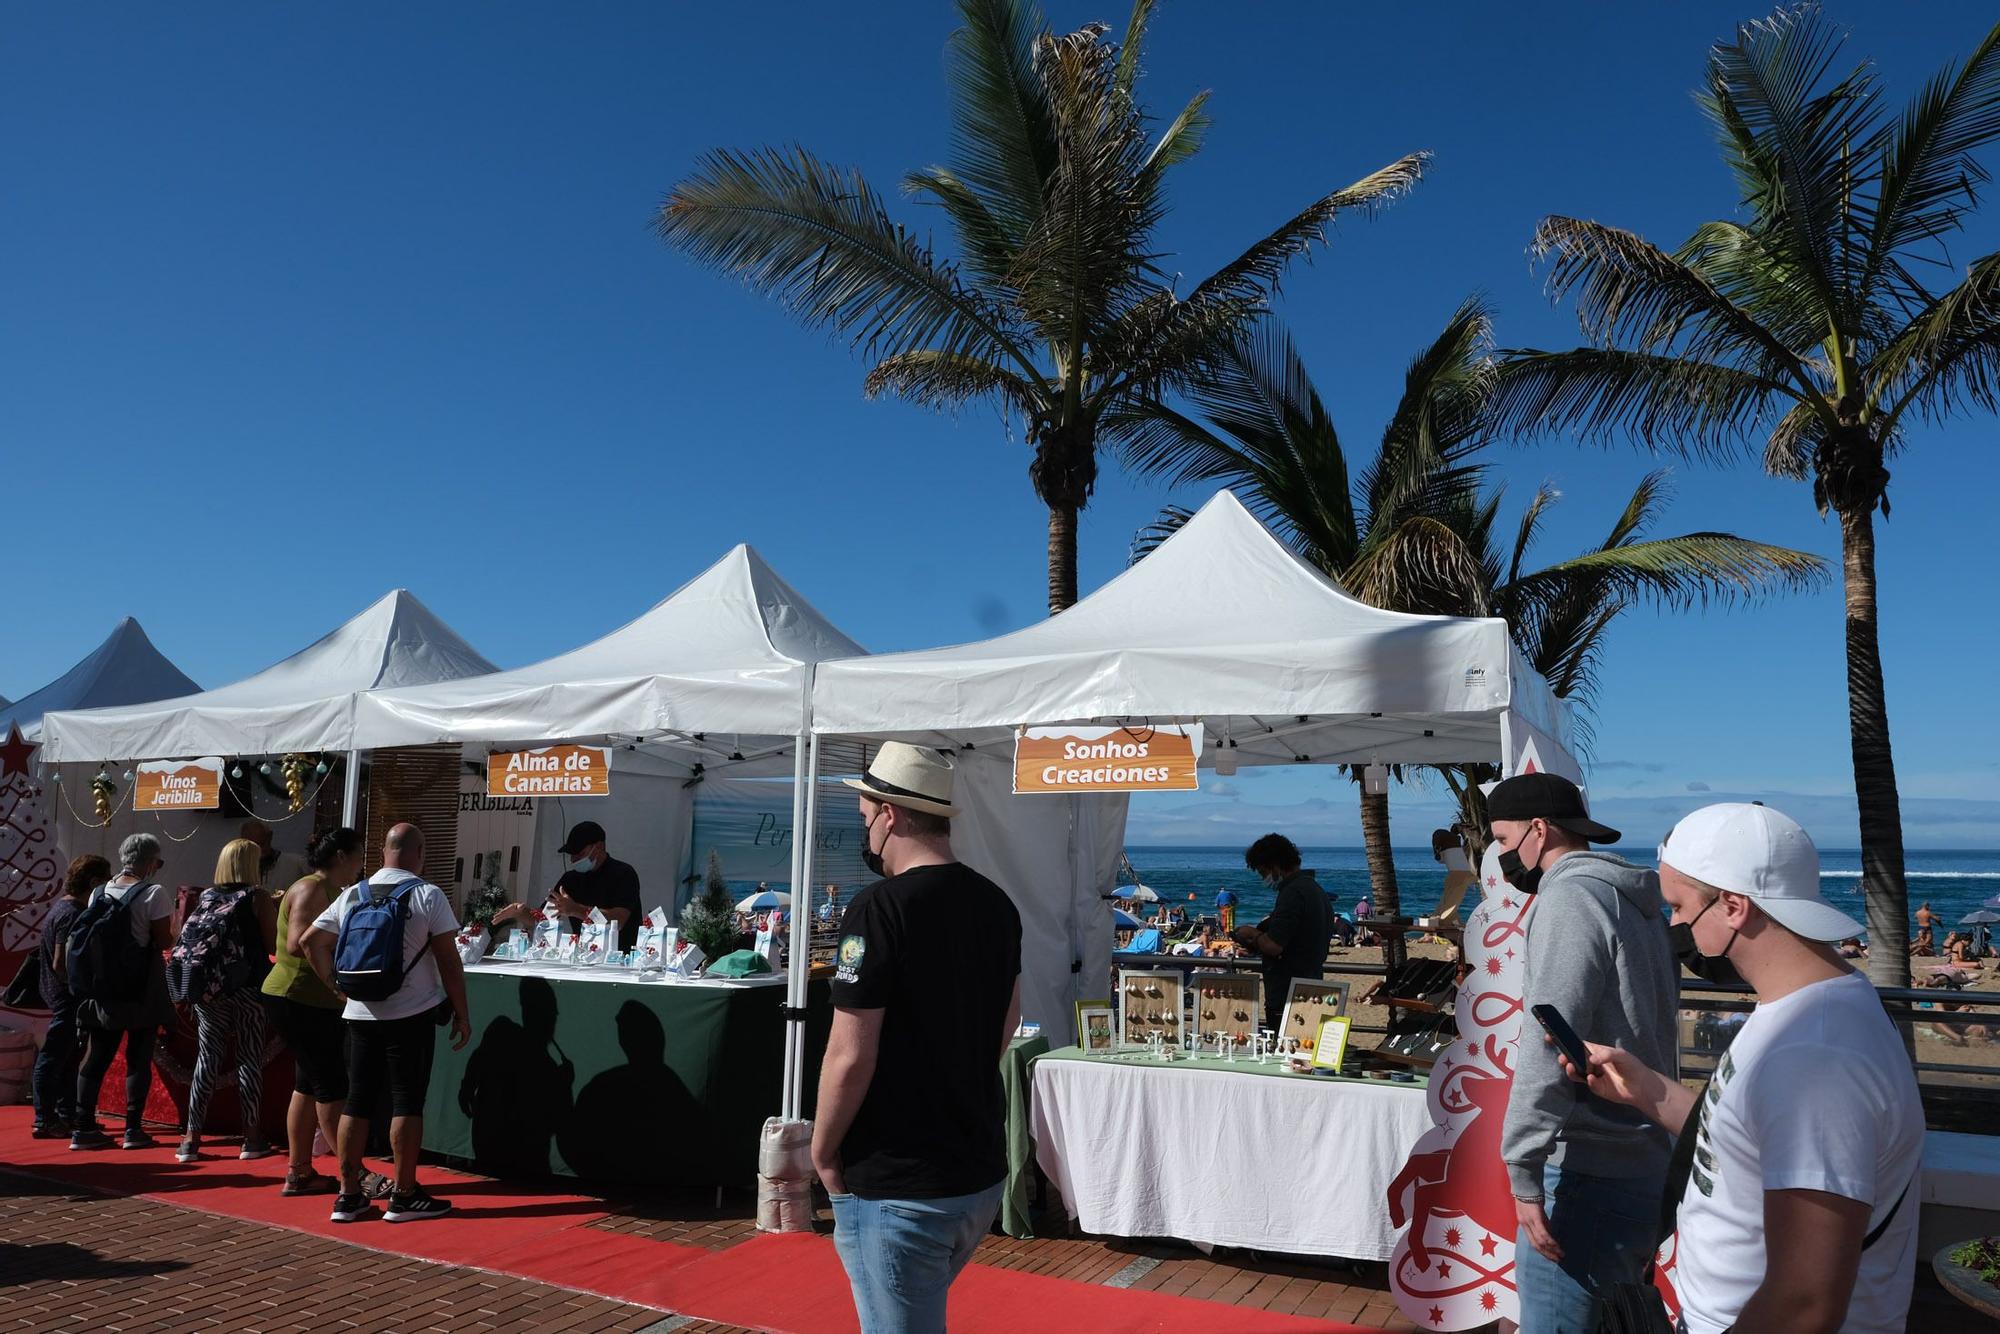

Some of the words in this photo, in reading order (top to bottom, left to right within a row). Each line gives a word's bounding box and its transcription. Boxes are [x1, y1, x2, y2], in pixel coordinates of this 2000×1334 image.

[1063, 740, 1149, 760] Sonhos
[506, 753, 559, 772] Alma
[564, 751, 591, 771] de
[161, 774, 197, 789] Vinos
[504, 772, 592, 793] Canarias
[1042, 764, 1169, 784] Creaciones
[151, 790, 203, 805] Jeribilla
[754, 812, 845, 868] Perfes
